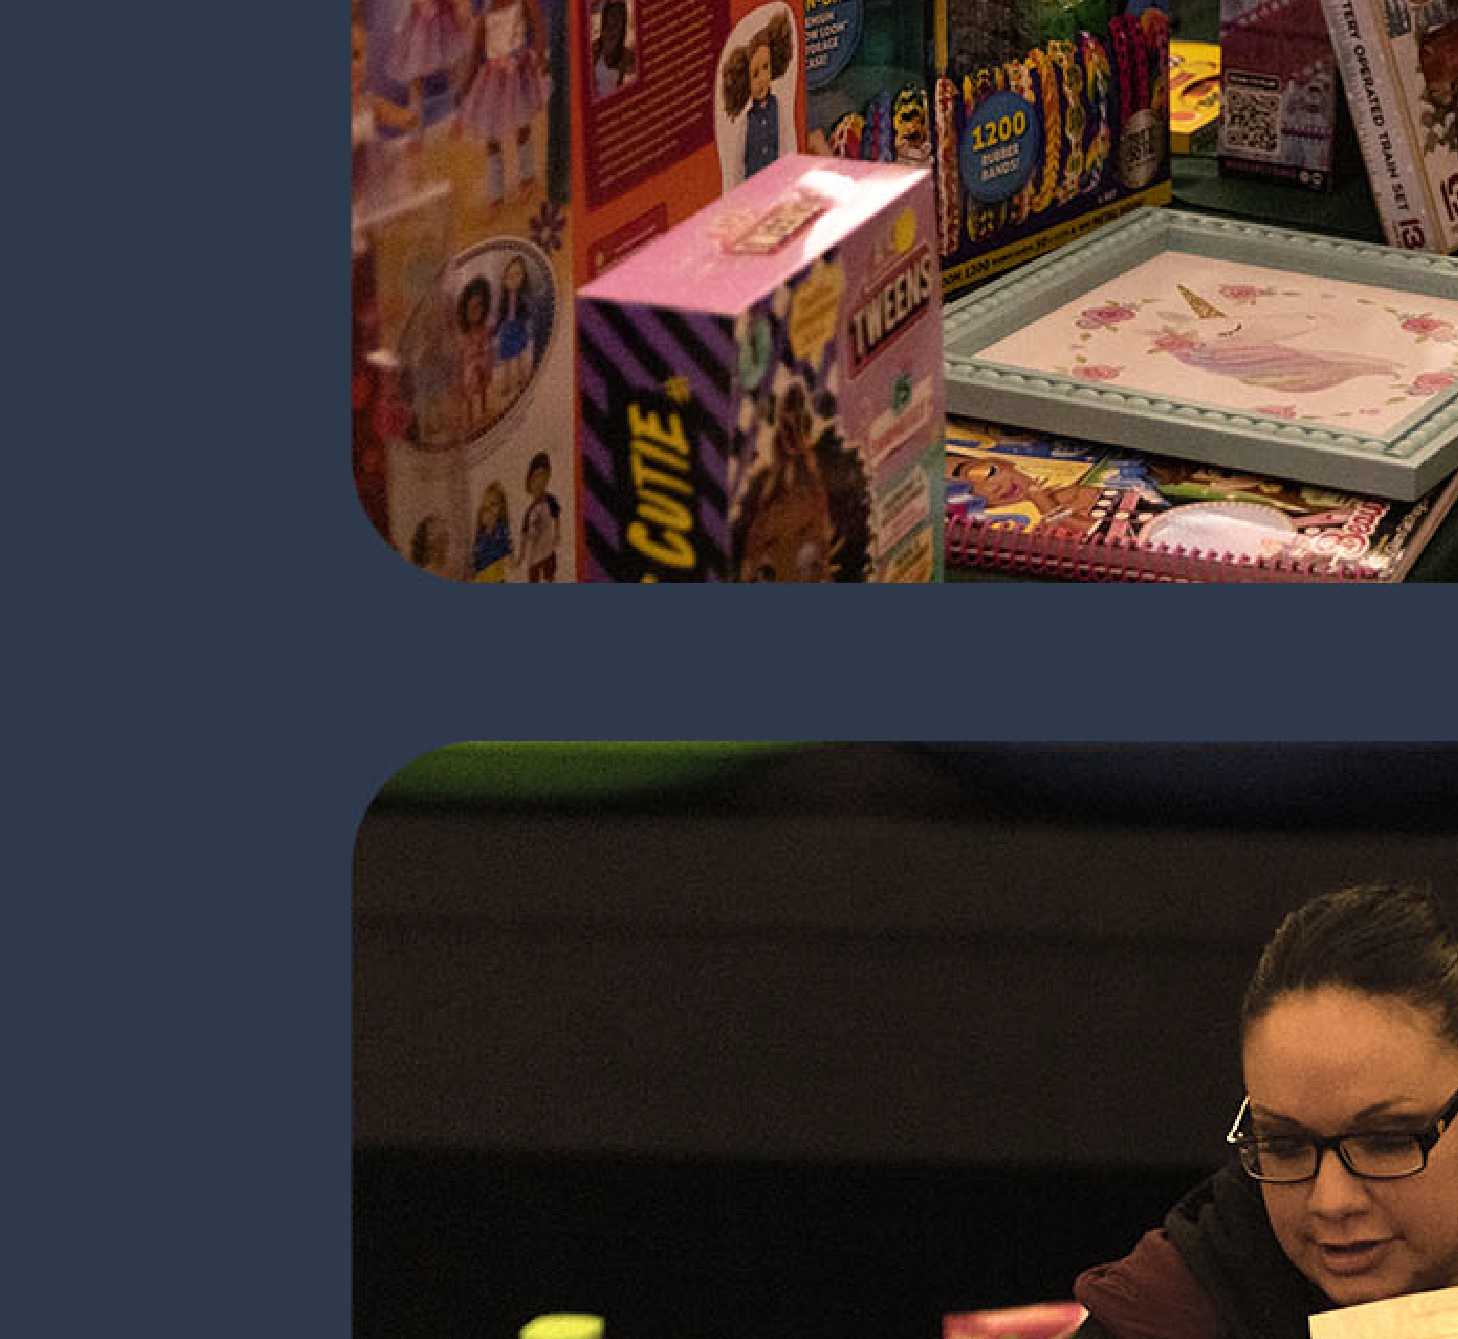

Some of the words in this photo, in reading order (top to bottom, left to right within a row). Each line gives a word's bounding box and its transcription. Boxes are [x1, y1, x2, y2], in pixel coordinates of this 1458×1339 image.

[971, 110, 1027, 154] 1200
[1354, 44, 1385, 127] OPERATED
[1378, 131, 1399, 178] TRAIN
[1391, 183, 1409, 213] SET
[851, 255, 932, 356] TWEENS
[625, 402, 697, 571] CUTIE
